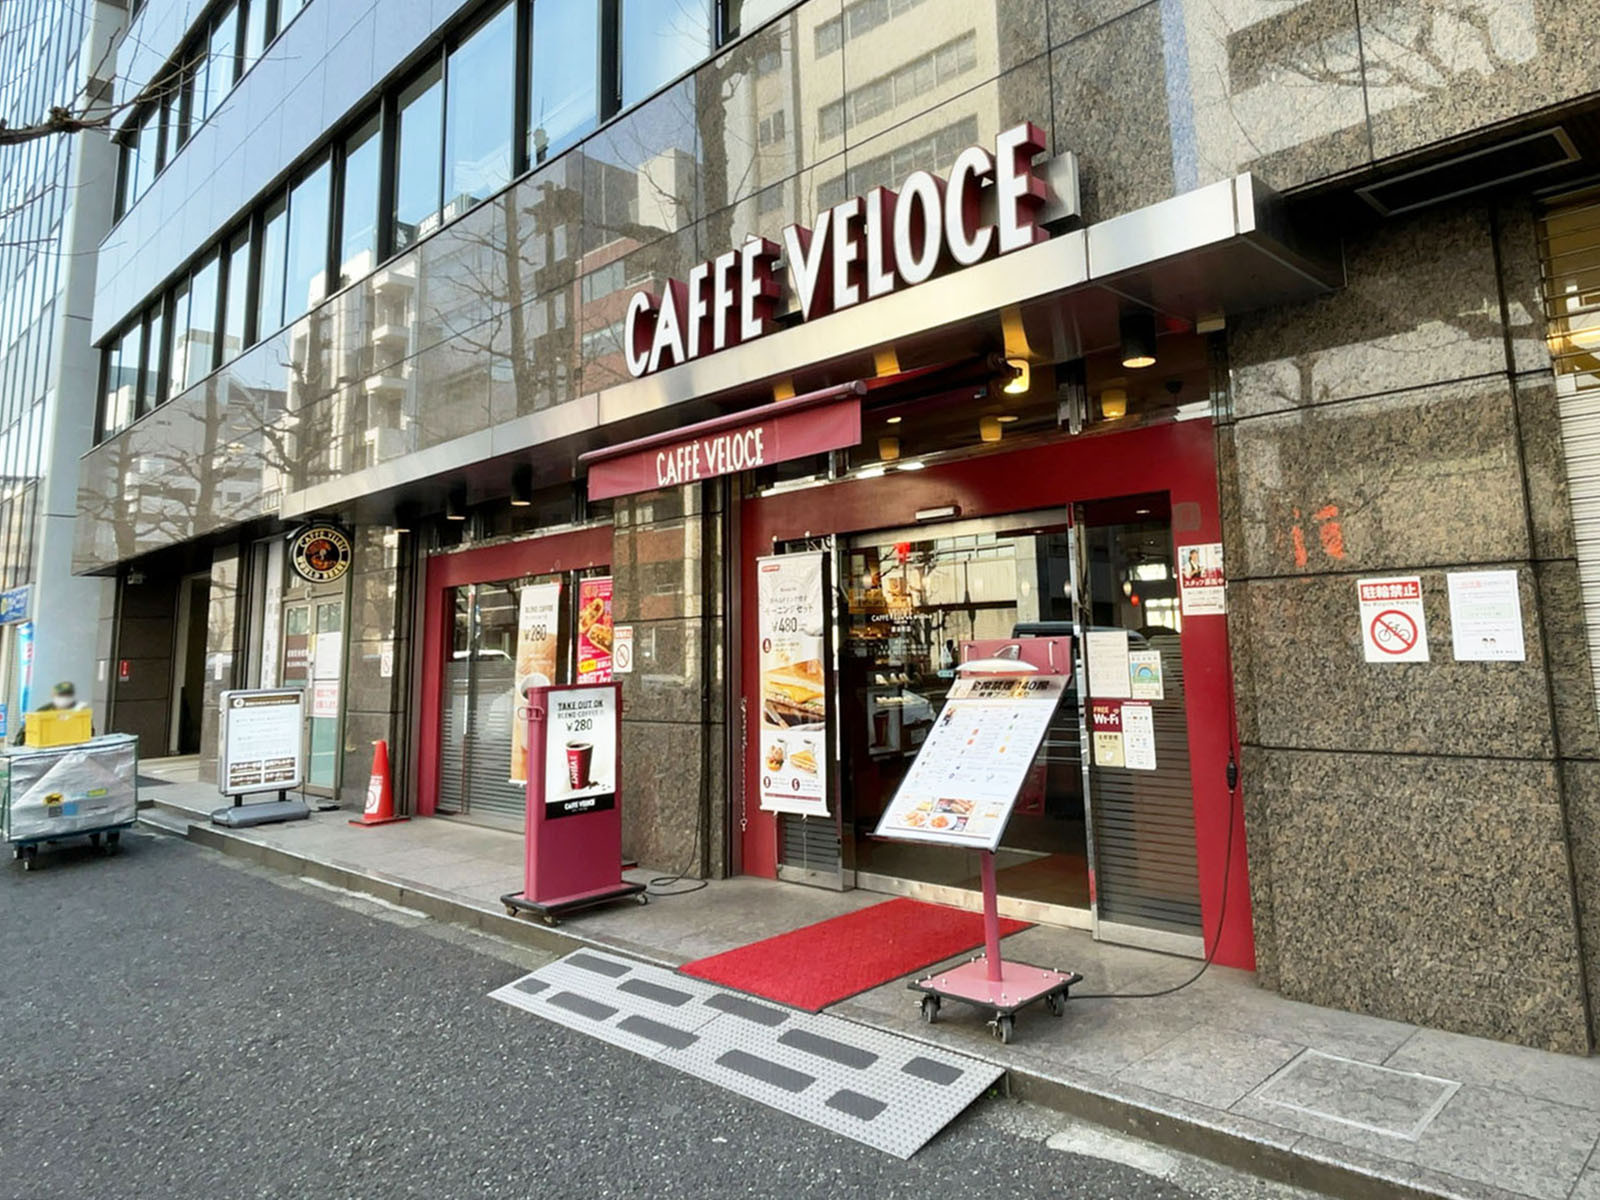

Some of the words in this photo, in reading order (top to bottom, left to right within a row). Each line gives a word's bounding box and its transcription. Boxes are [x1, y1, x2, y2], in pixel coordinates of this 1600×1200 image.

[624, 233, 765, 378] CAFFÈ
[783, 121, 1034, 322] VELOCE
[704, 427, 764, 473] VELOCE
[1362, 583, 1418, 599] 駐輪禁止
[557, 702, 576, 711] TAKE
[578, 700, 592, 709] OUT
[566, 718, 592, 731] ¥280
[1093, 713, 1119, 724] Wi-Fi
